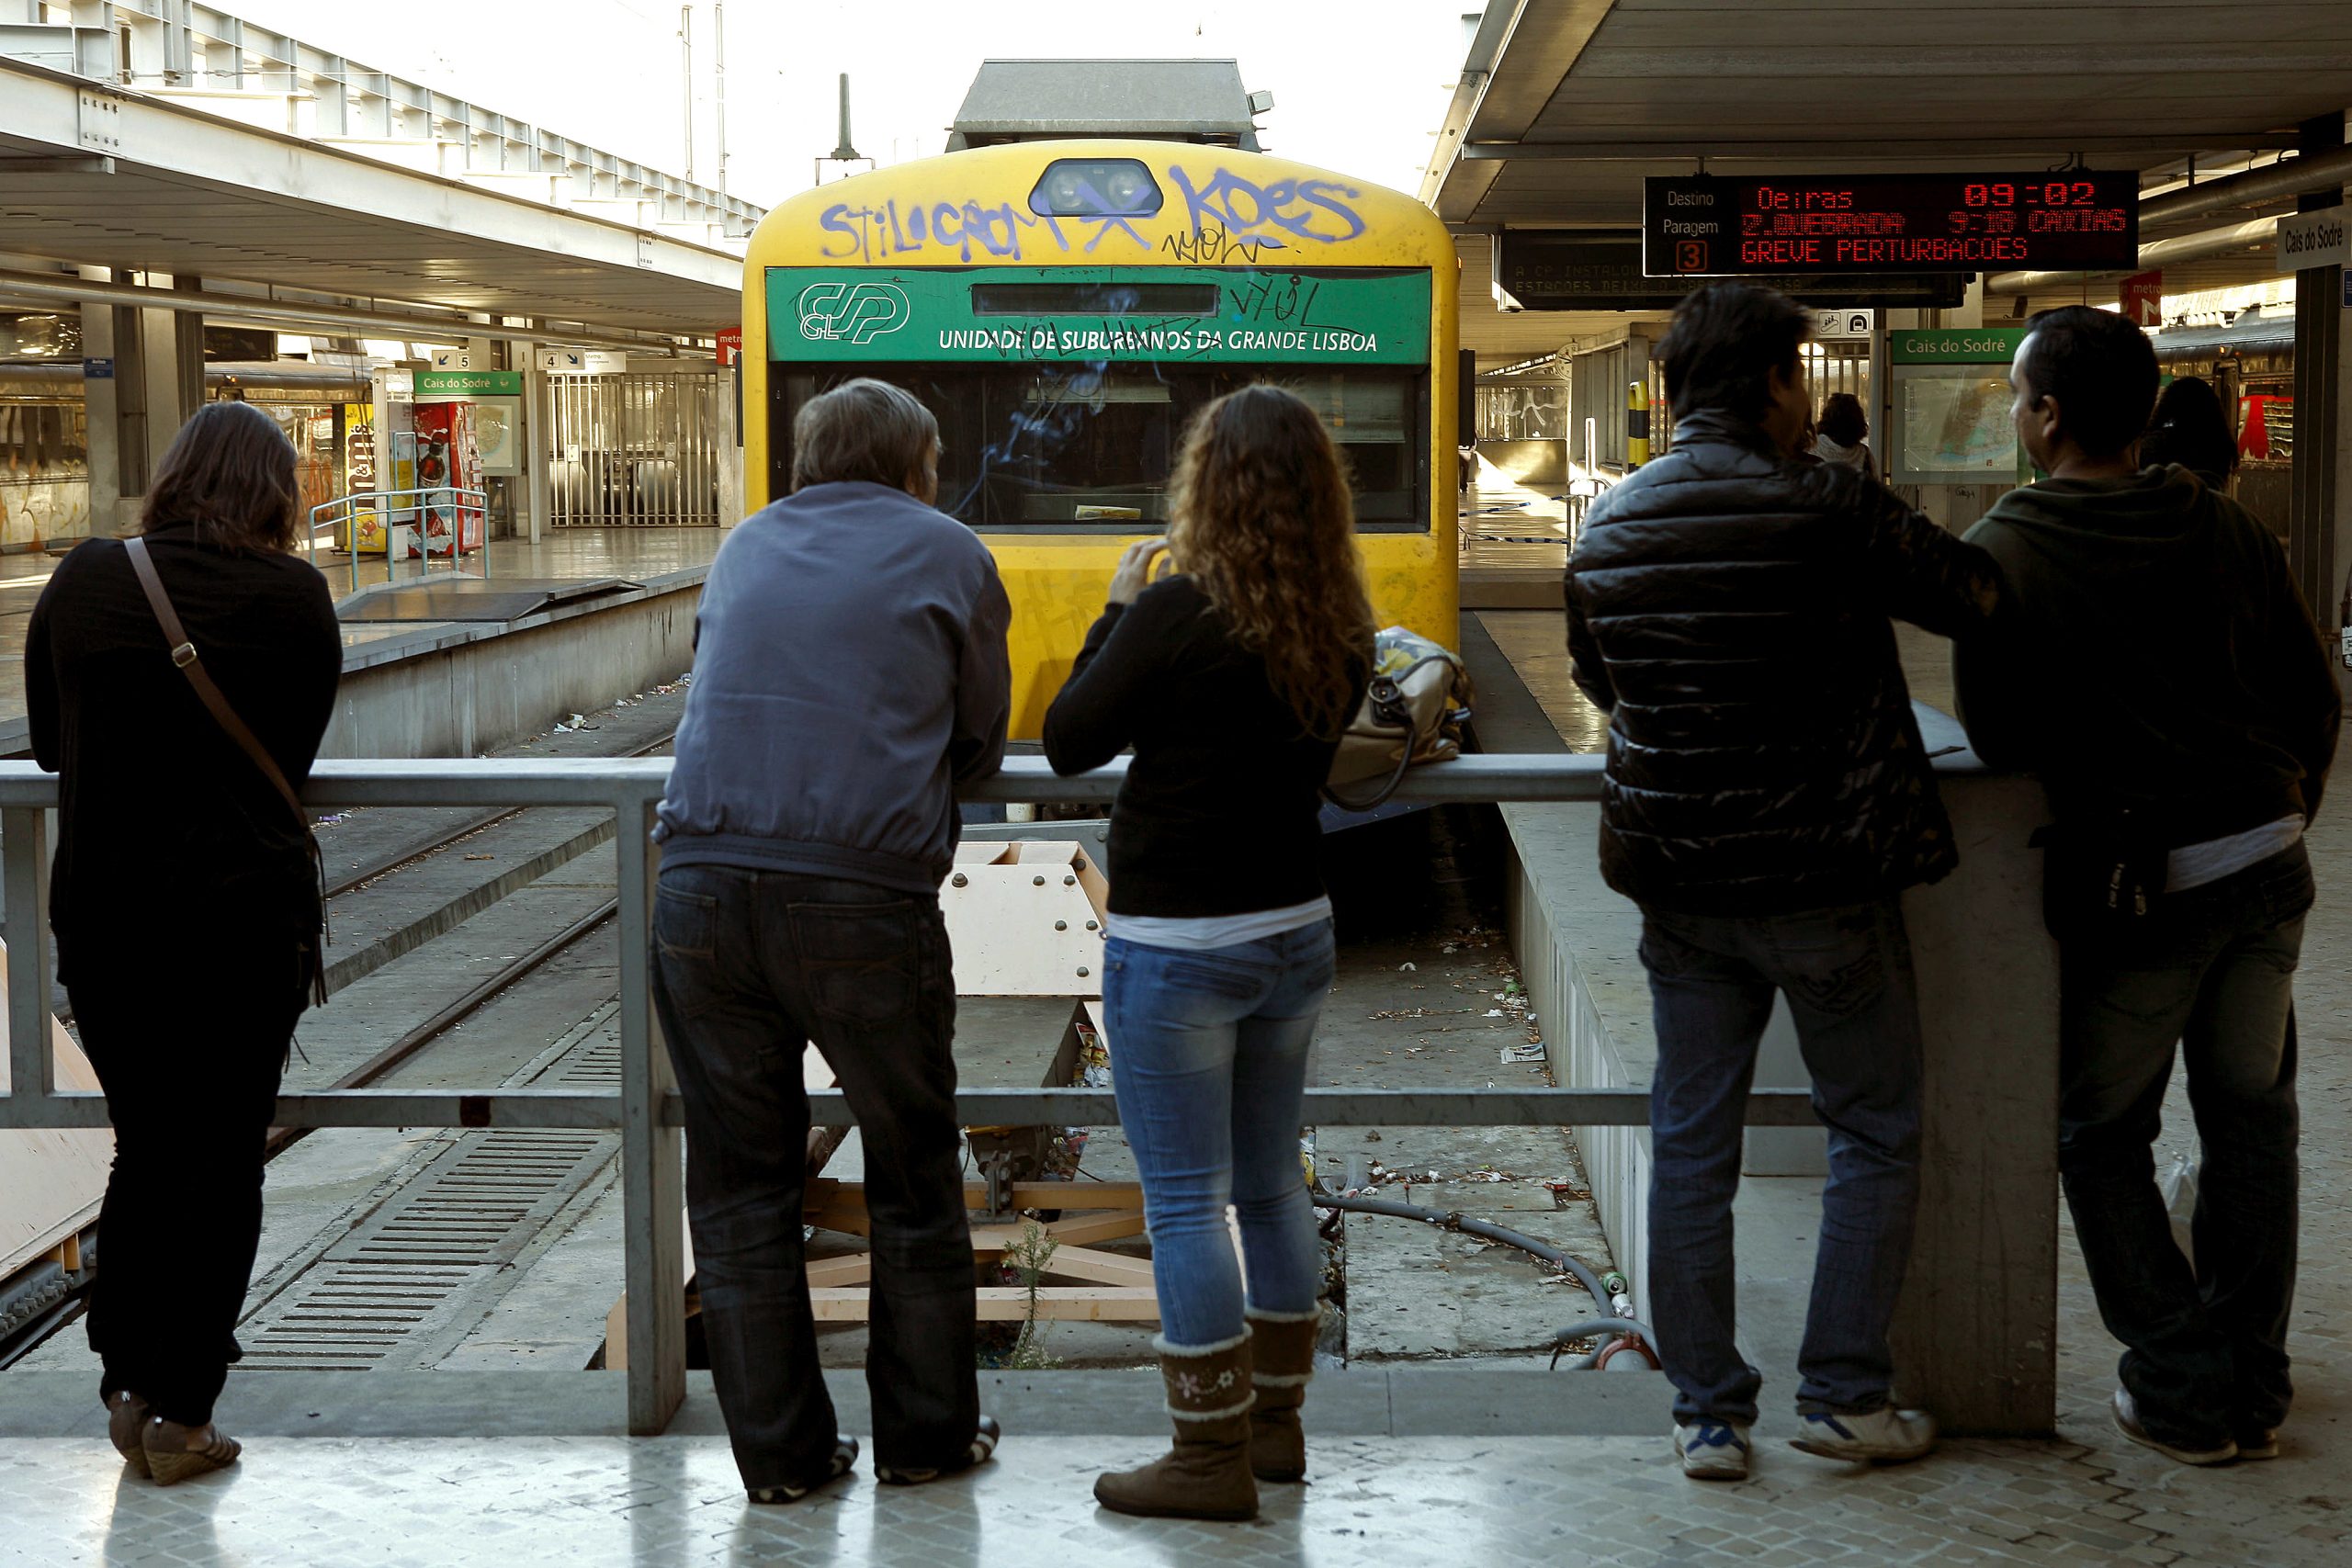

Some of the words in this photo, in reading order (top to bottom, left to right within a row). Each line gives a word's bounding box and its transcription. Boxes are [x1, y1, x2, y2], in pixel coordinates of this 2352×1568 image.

[1668, 190, 1714, 207] Destino
[1758, 186, 1853, 209] Oeiras
[1964, 183, 2095, 207] 09:02
[1663, 219, 1719, 237] Paragem
[2285, 229, 2303, 254] Cais
[2305, 227, 2315, 251] do
[2317, 220, 2343, 250] Sodré
[1683, 243, 1700, 268] 3
[1742, 240, 1821, 263] GREVE
[1838, 238, 2029, 262] PERTURBACOES
[939, 330, 1026, 350] UNIDADE
[1031, 331, 1056, 350] DE
[1061, 331, 1192, 351] SUBURBANOS
[1196, 331, 1223, 350] DA
[1228, 331, 1312, 351] GRANDE
[1313, 333, 1377, 352] LISBOA
[1905, 338, 1937, 354] Cais
[1940, 338, 1959, 353] do
[1962, 337, 2007, 353] Sodré
[461, 356, 469, 367] 5
[548, 356, 555, 367] 4
[424, 378, 446, 389] Cais
[448, 378, 460, 389] do
[462, 377, 491, 389] Sodré
